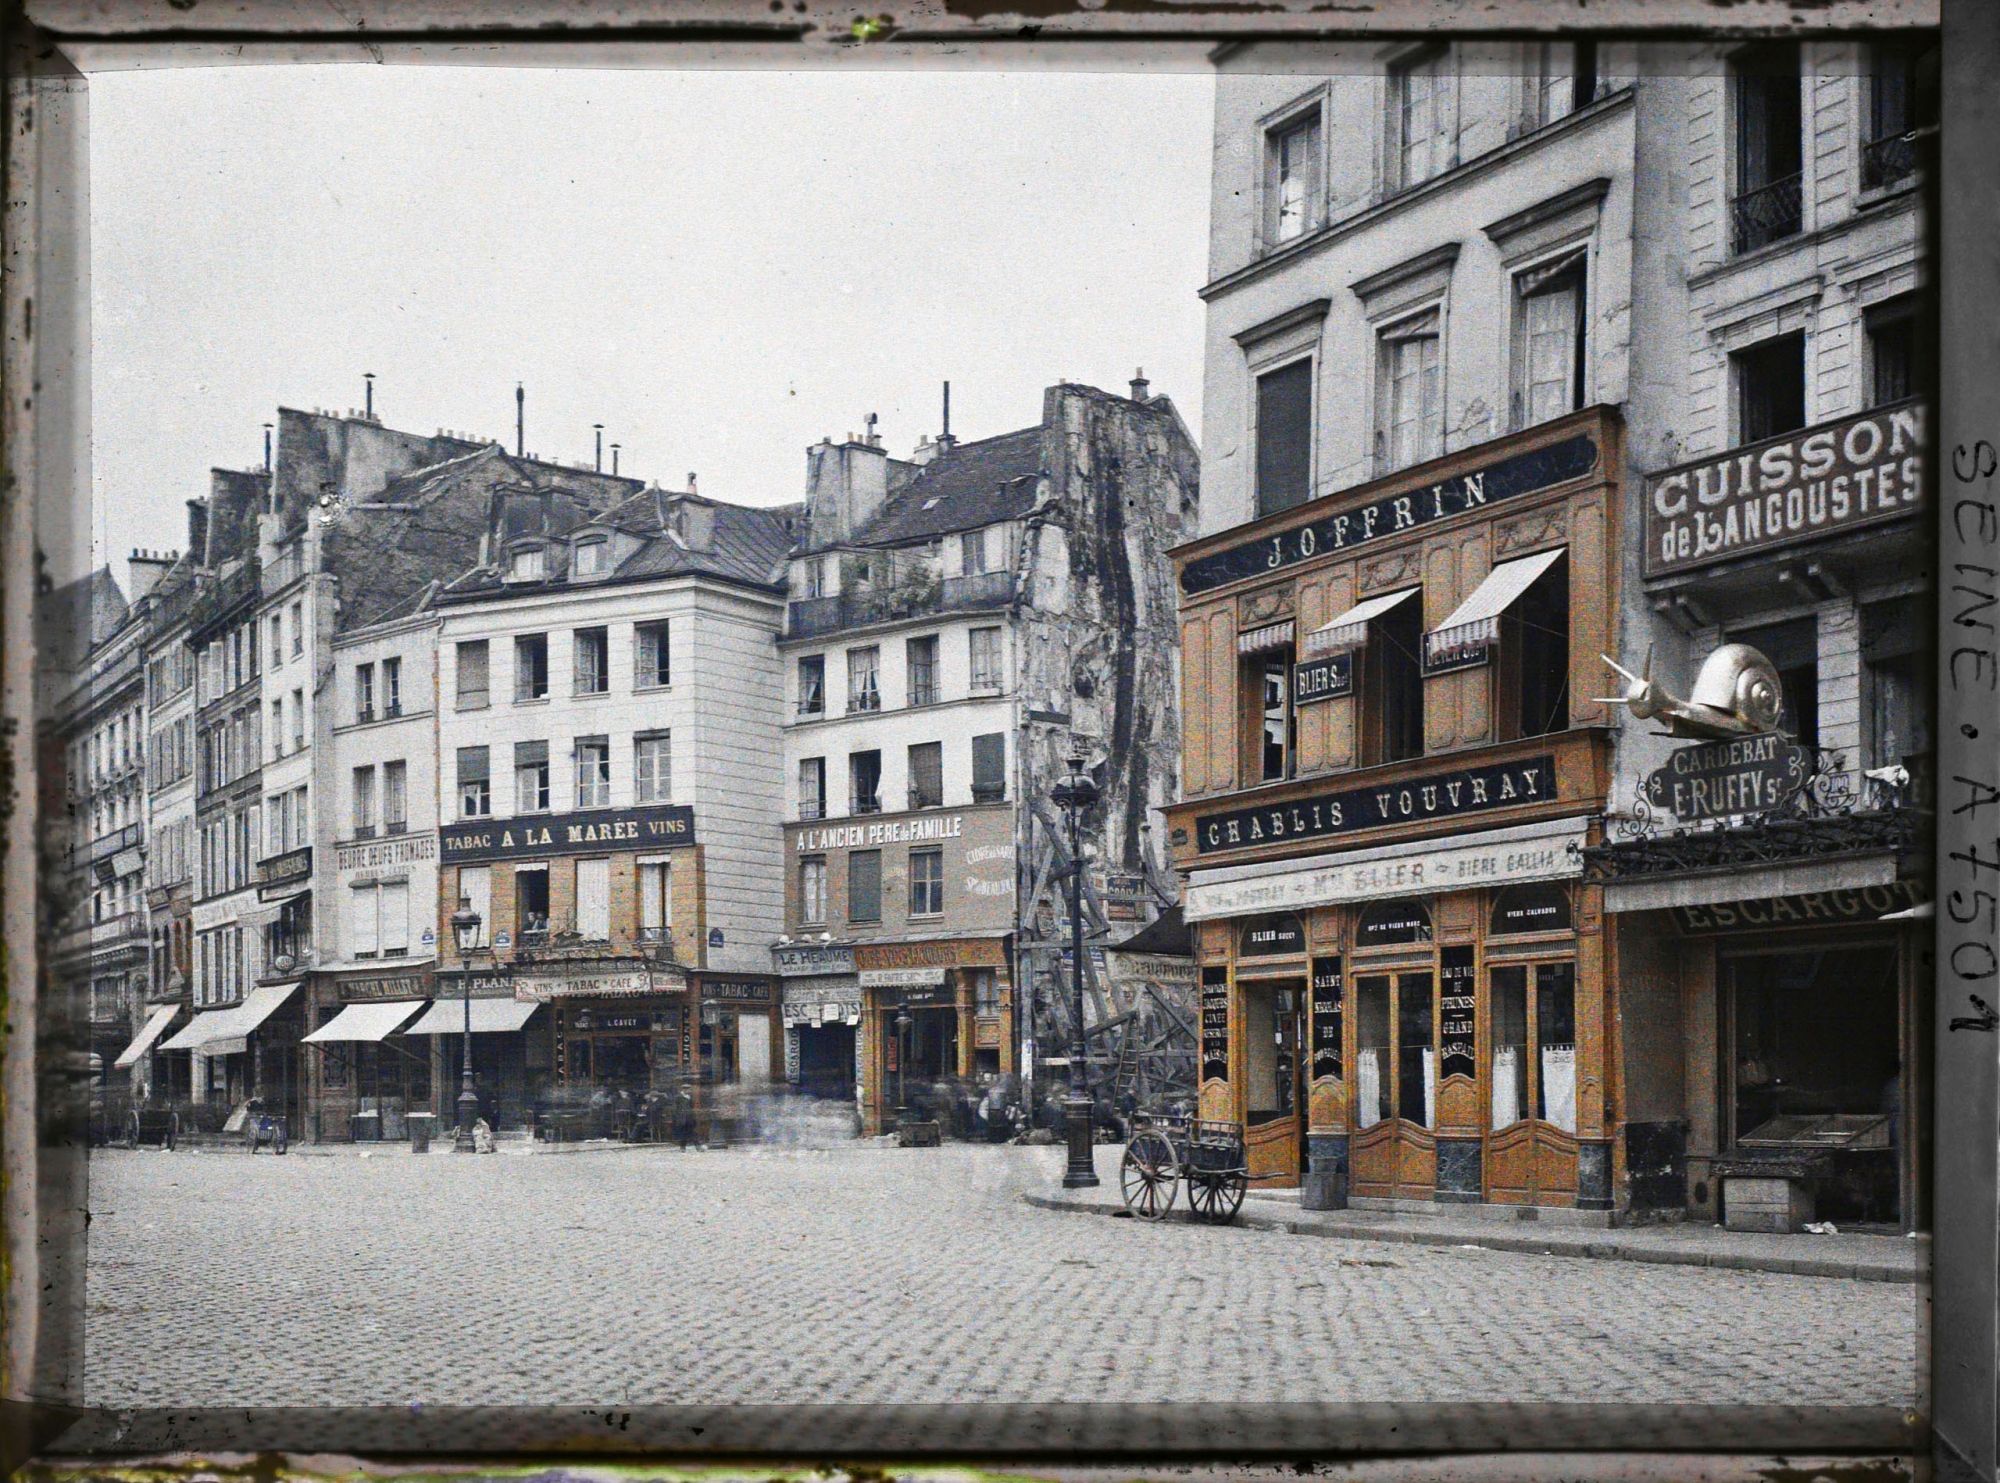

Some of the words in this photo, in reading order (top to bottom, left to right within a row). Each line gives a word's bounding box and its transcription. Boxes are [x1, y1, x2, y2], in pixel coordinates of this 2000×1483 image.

[1655, 404, 1927, 517] CUISSON
[1268, 471, 1488, 568] JOFFRIN
[1661, 520, 1690, 562] de
[1299, 667, 1328, 696] BLIER
[1208, 802, 1343, 847] CHABLIS
[1376, 769, 1540, 819] VOUVRAY
[445, 834, 491, 851] TABAC
[501, 830, 515, 848] A
[526, 828, 553, 846] LA
[567, 818, 639, 843] MARÉE
[648, 820, 686, 835] VINS
[797, 831, 805, 850] A
[910, 816, 962, 841] FAMILLE
[780, 953, 798, 965] LE
[567, 979, 600, 991] TABAC
[720, 983, 748, 998] TABAC
[1314, 974, 1341, 988] SAINT
[1442, 1020, 1474, 1035] GRAND
